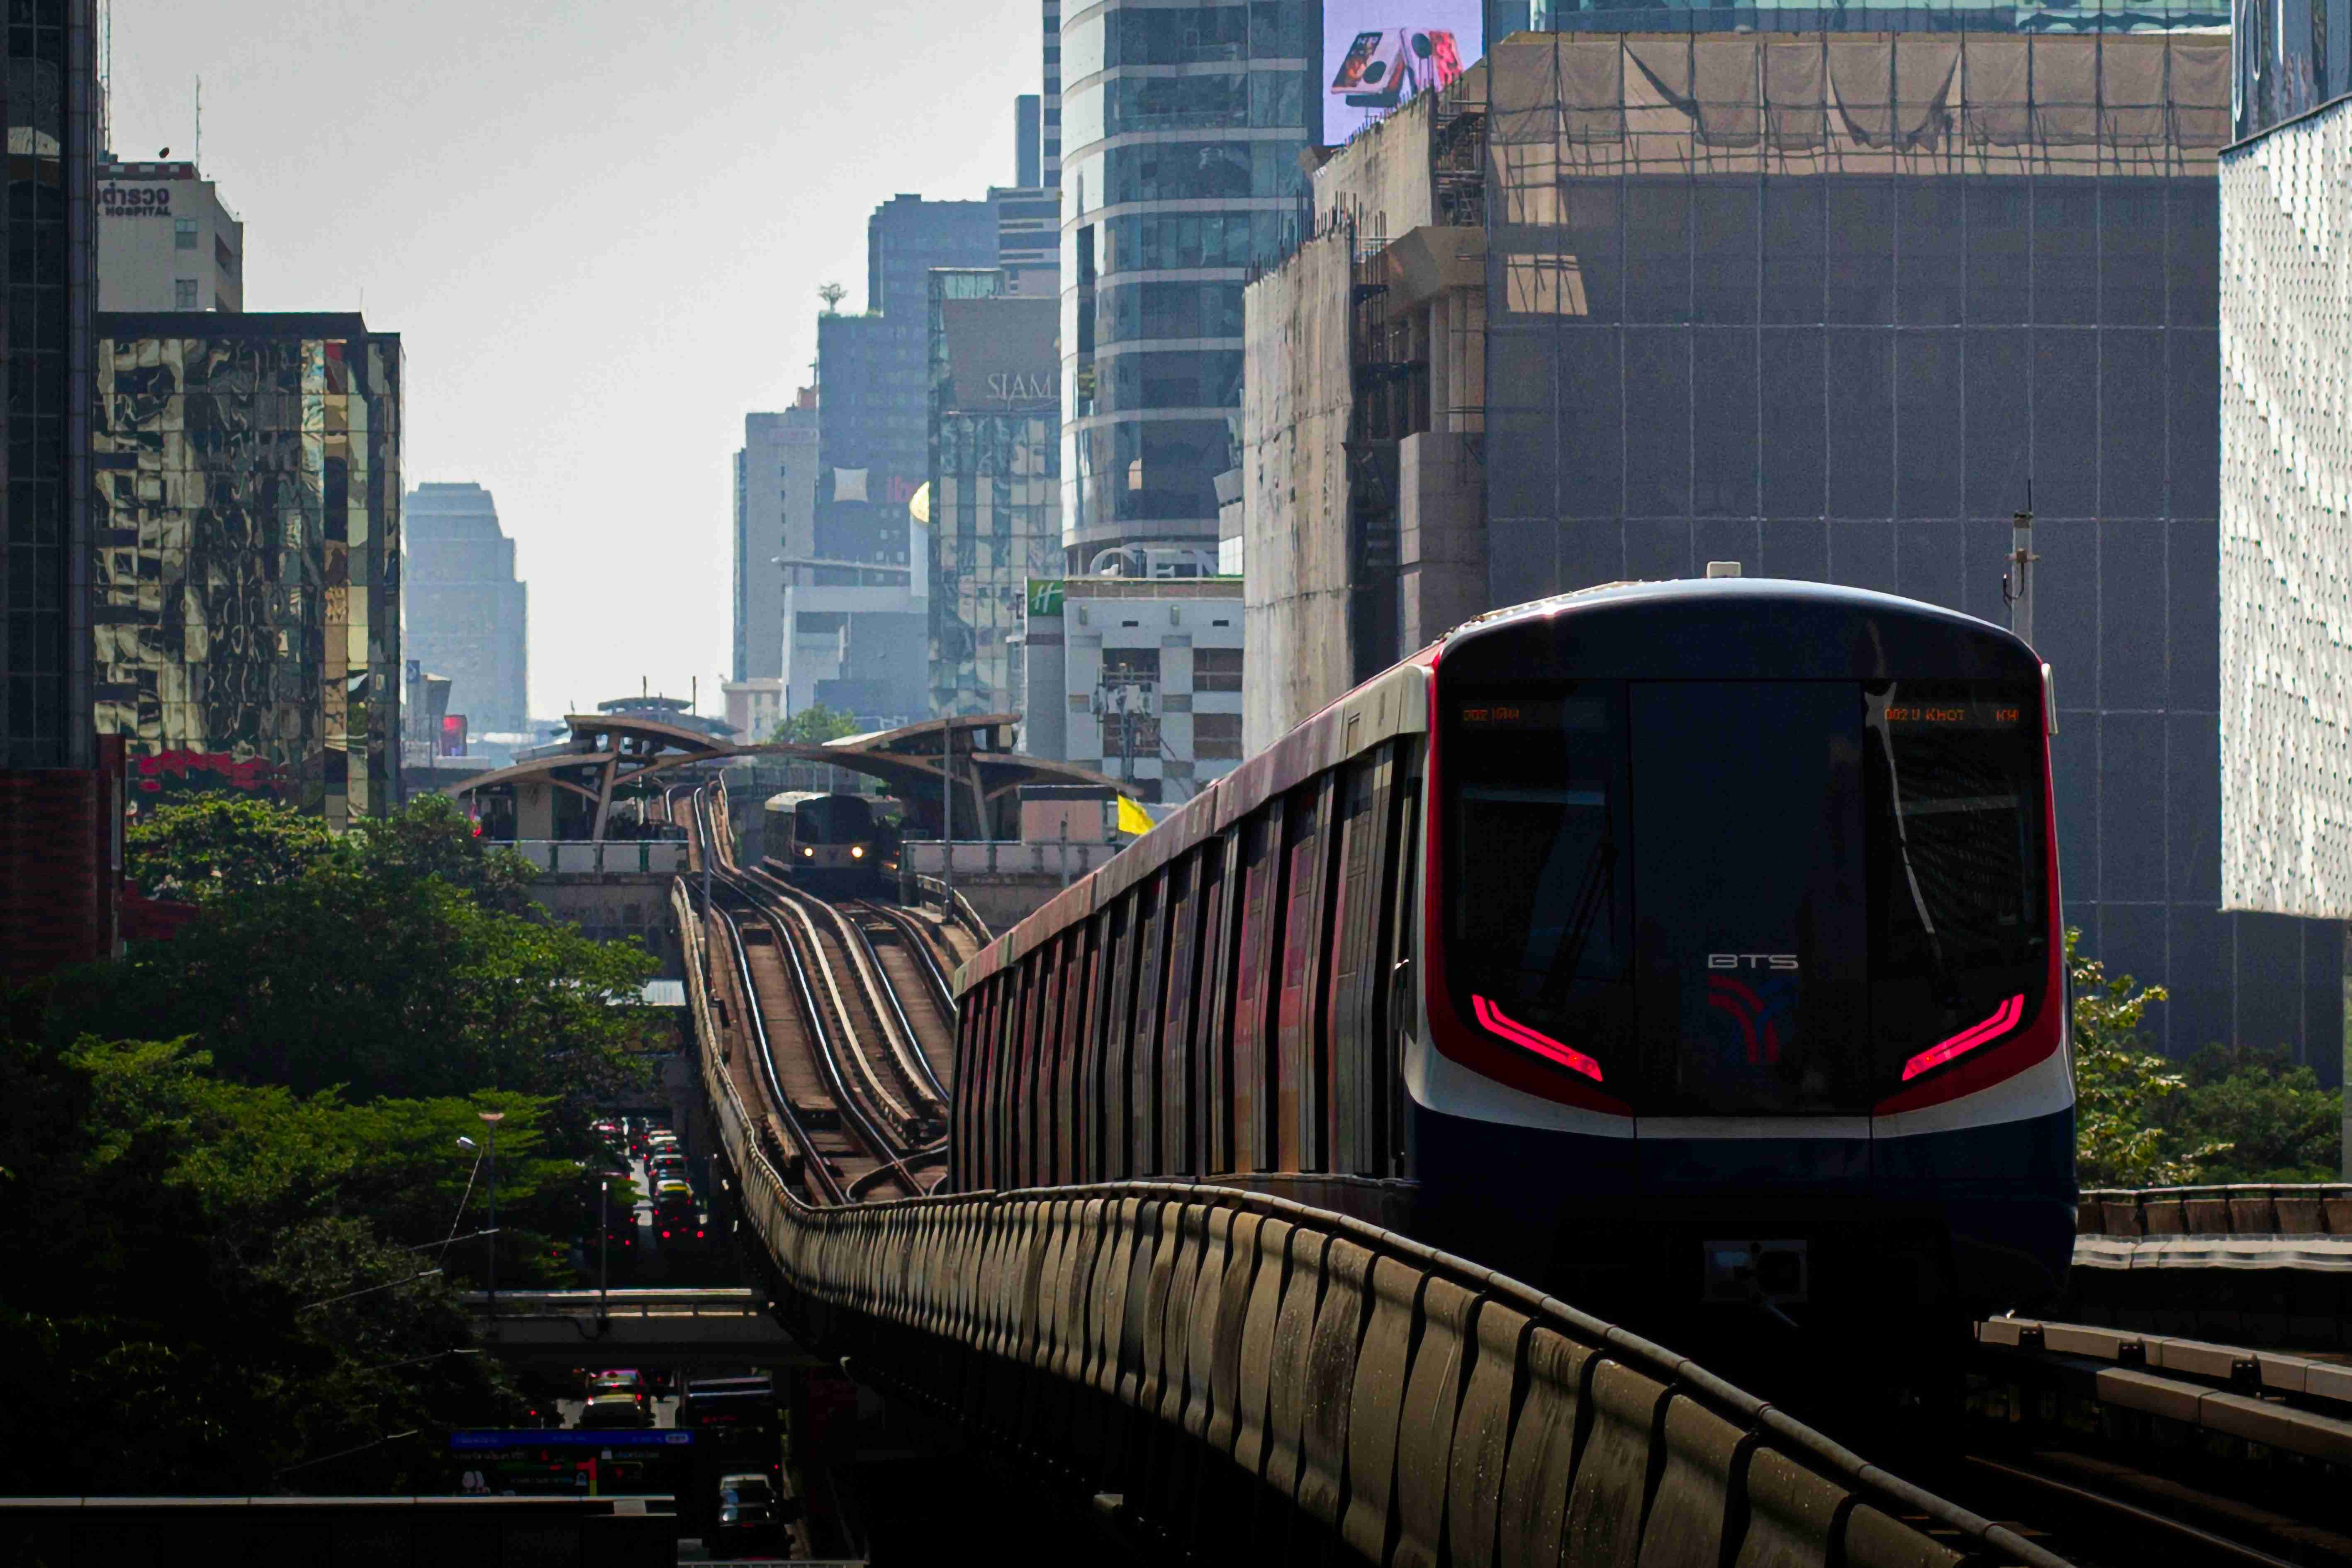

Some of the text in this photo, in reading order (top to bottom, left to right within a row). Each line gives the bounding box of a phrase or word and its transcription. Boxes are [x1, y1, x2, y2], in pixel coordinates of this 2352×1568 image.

[106, 207, 171, 216] HOSPITAL
[987, 373, 1053, 403] SIAM
[886, 475, 918, 504] ib
[1708, 954, 1798, 969] BTS
